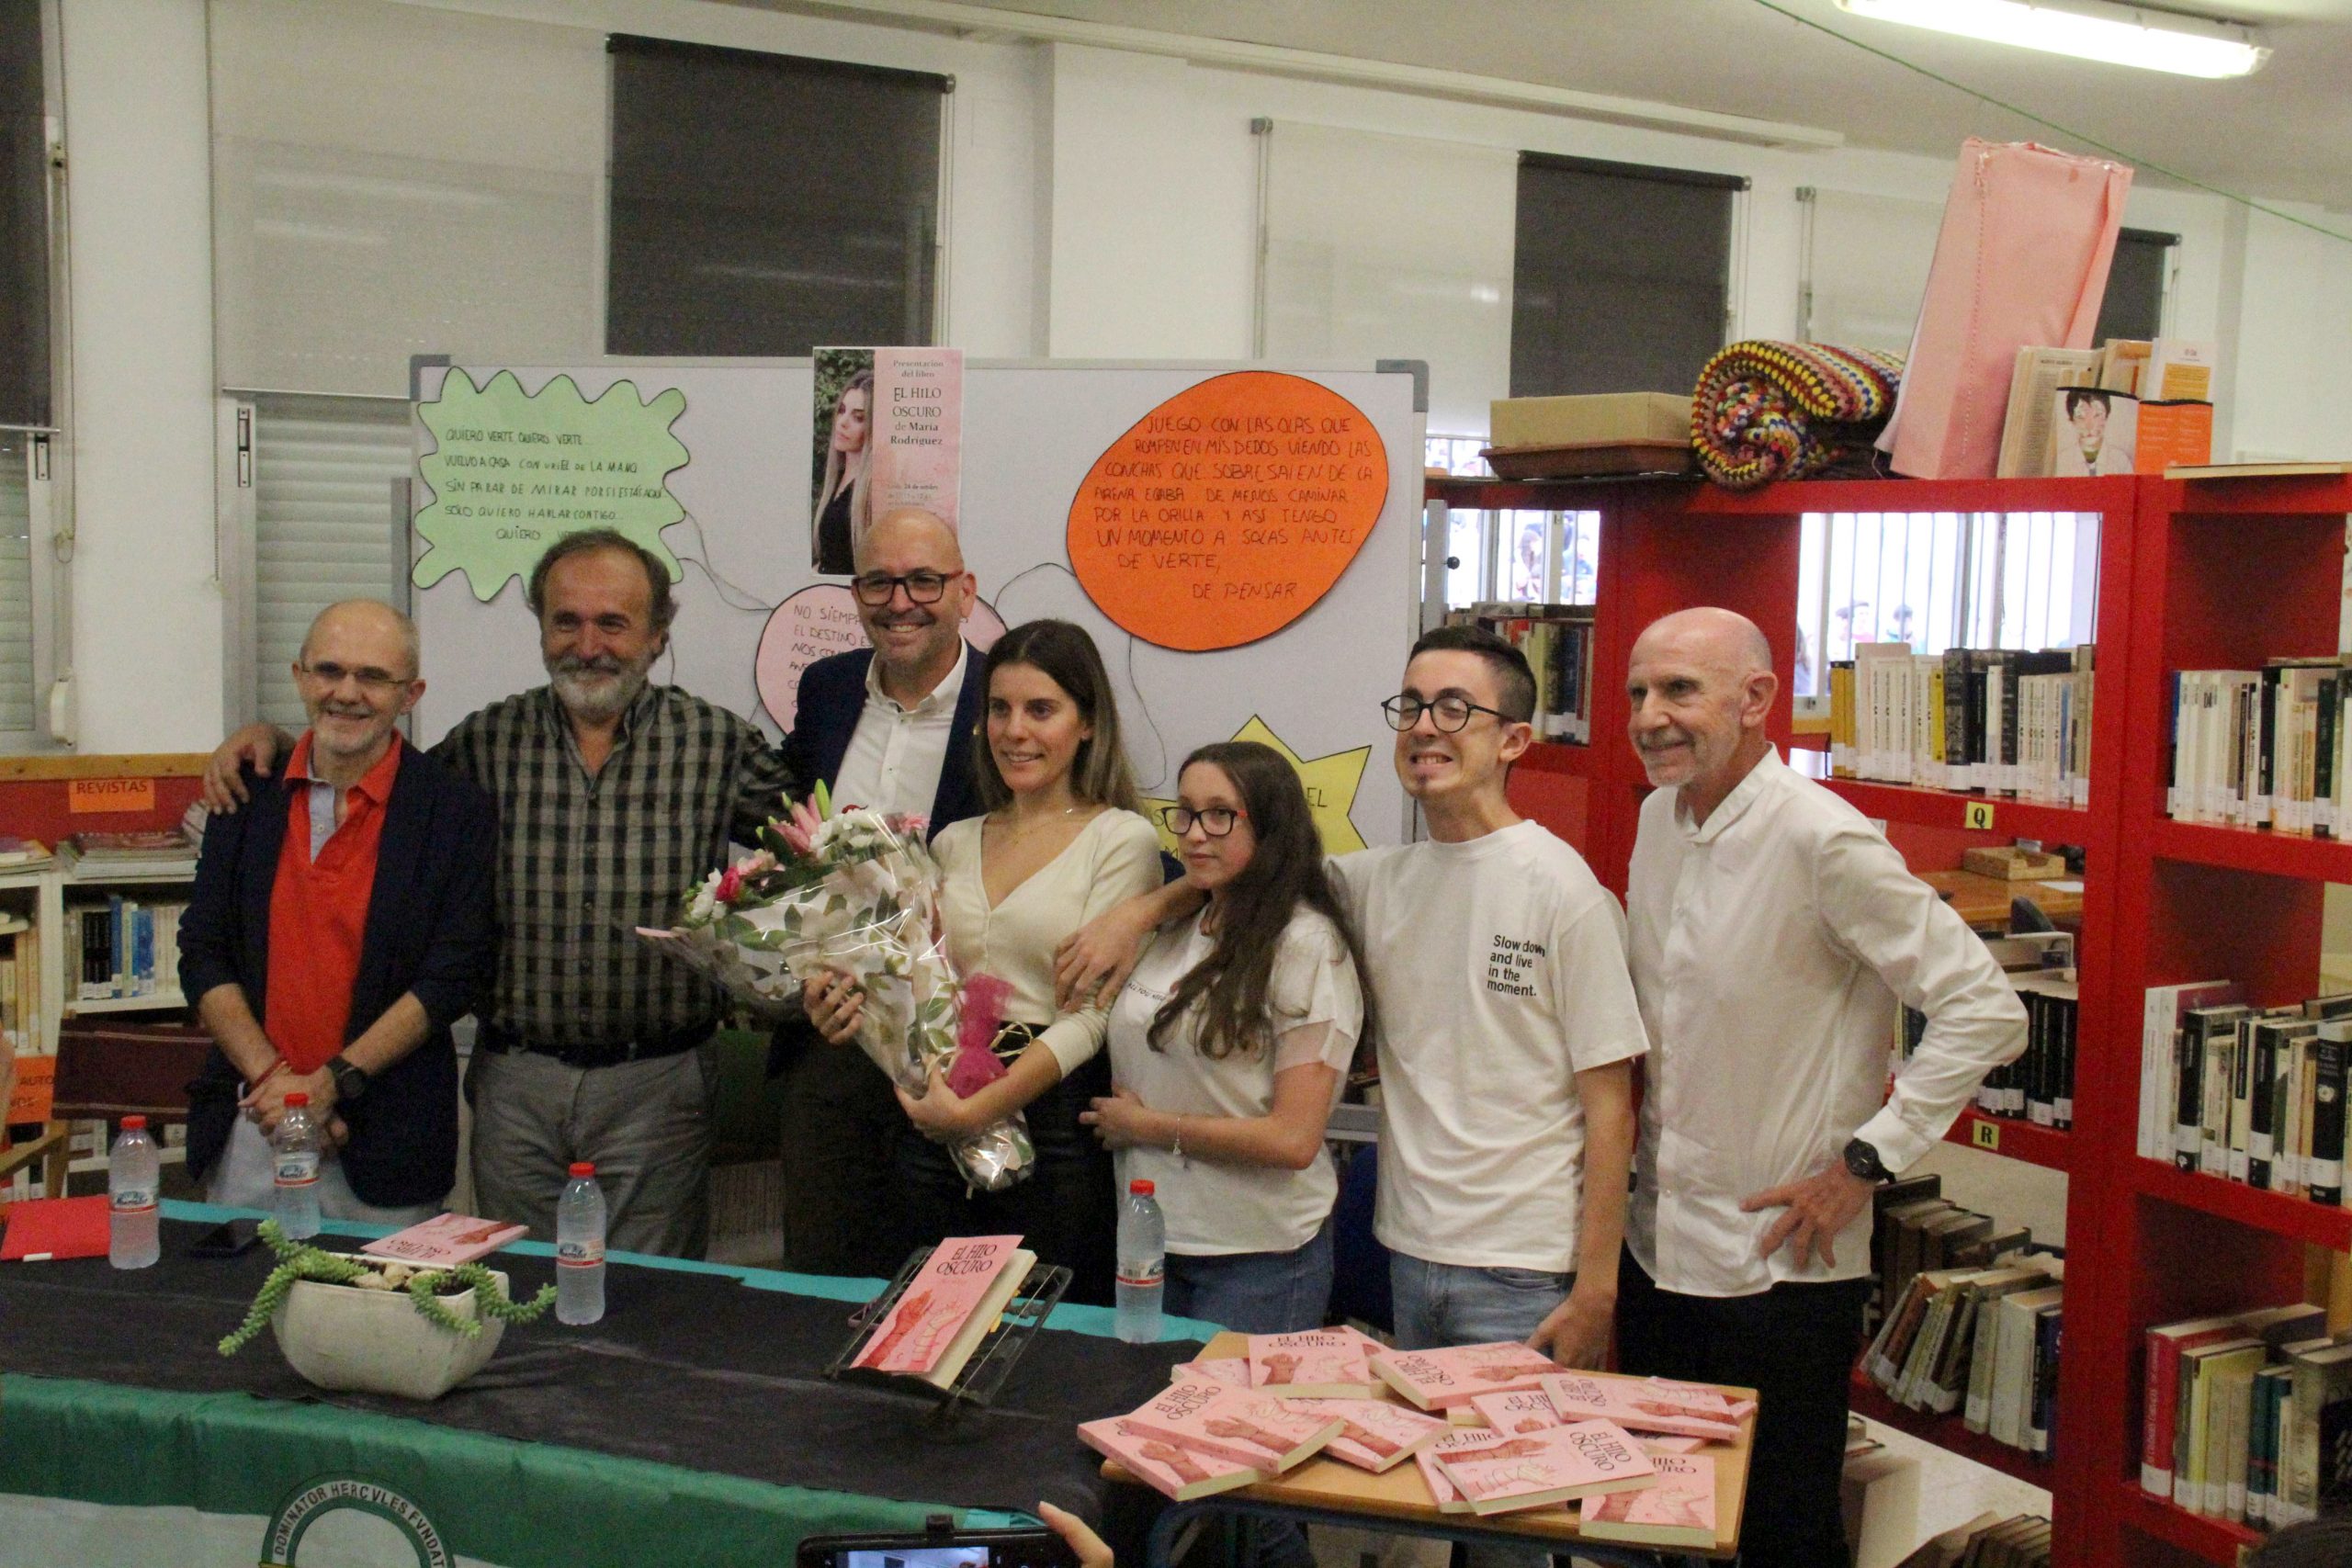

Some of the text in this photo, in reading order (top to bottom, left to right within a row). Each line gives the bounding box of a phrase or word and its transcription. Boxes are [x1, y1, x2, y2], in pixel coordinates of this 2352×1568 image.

[894, 387, 942, 402] EL HILO
[892, 406, 942, 418] OSCURO
[1148, 417, 1201, 434] JUEGO
[1211, 417, 1238, 432] CON
[1247, 418, 1273, 434] LAS
[1321, 417, 1351, 434] QUE
[1234, 439, 1279, 457] DEDOS
[1349, 441, 1372, 458] LAS
[480, 457, 487, 467] A
[519, 459, 540, 469] CON
[591, 461, 603, 472] LA
[1171, 462, 1203, 481] QUE
[1329, 464, 1347, 482] DE
[470, 481, 505, 494] PARAR
[512, 483, 525, 494] DE
[531, 484, 577, 496] MIRAR
[585, 486, 603, 497] POR
[1095, 487, 1135, 502] ARENA
[1206, 488, 1225, 502] DE
[1232, 489, 1278, 502] MENOS
[479, 506, 521, 517] QUIERO
[1094, 507, 1121, 523] POR
[1132, 508, 1148, 523] LA
[1159, 508, 1204, 523] ORILLA
[1283, 508, 1337, 524] TENGO
[1098, 529, 1123, 547] UN
[1128, 529, 1204, 547] MOMENTO
[1214, 531, 1225, 546] A
[1301, 528, 1355, 544] ANTES
[1118, 553, 1142, 570] DE
[1193, 582, 1297, 600] DE PENSAR
[794, 604, 811, 619] NO
[794, 624, 805, 637] EL
[809, 627, 856, 646] DESTINO
[791, 643, 816, 657] NOS
[76, 777, 147, 794] REVISTAS
[1973, 807, 1985, 829] Q
[1493, 934, 1545, 957] Slow down
[1489, 952, 1532, 968] and live
[1488, 964, 1521, 982] in the
[1487, 979, 1537, 997] moment.
[1981, 1124, 1993, 1145] R
[951, 1244, 998, 1260] EL HILO
[936, 1259, 993, 1276] OSCURO
[1155, 1384, 1198, 1413] EL HILO
[1167, 1385, 1222, 1420] OSCURO
[1569, 1432, 1615, 1472] OSCURO
[1590, 1432, 1632, 1462] EL HILO
[274, 1486, 328, 1557] DOMINATOR
[331, 1482, 409, 1515] HERCVLES
